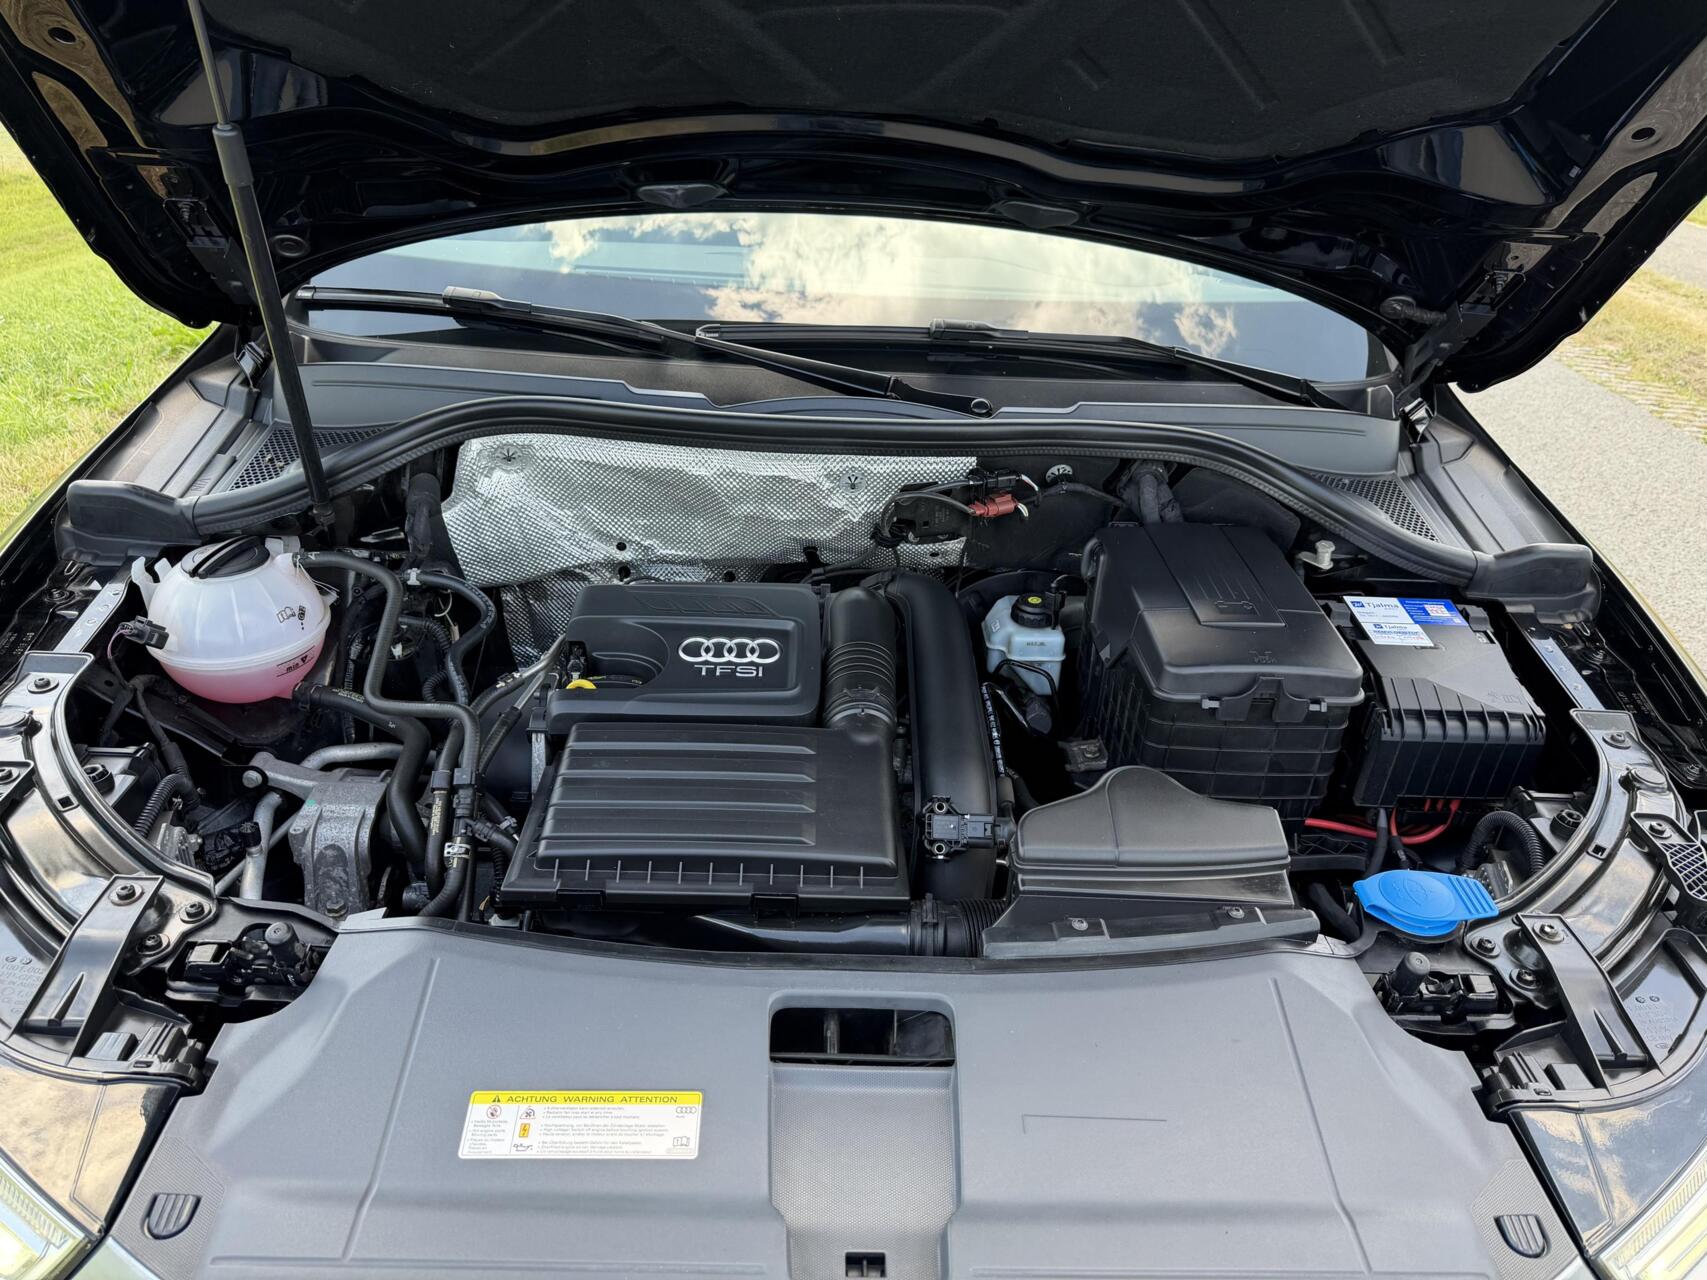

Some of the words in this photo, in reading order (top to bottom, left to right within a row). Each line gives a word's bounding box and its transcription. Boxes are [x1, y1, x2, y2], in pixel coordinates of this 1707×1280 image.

[694, 664, 763, 677] TFSI
[507, 1095, 557, 1103] ACHTUNG
[563, 1095, 615, 1103] WARNING
[620, 1095, 678, 1103] ATTENTION
